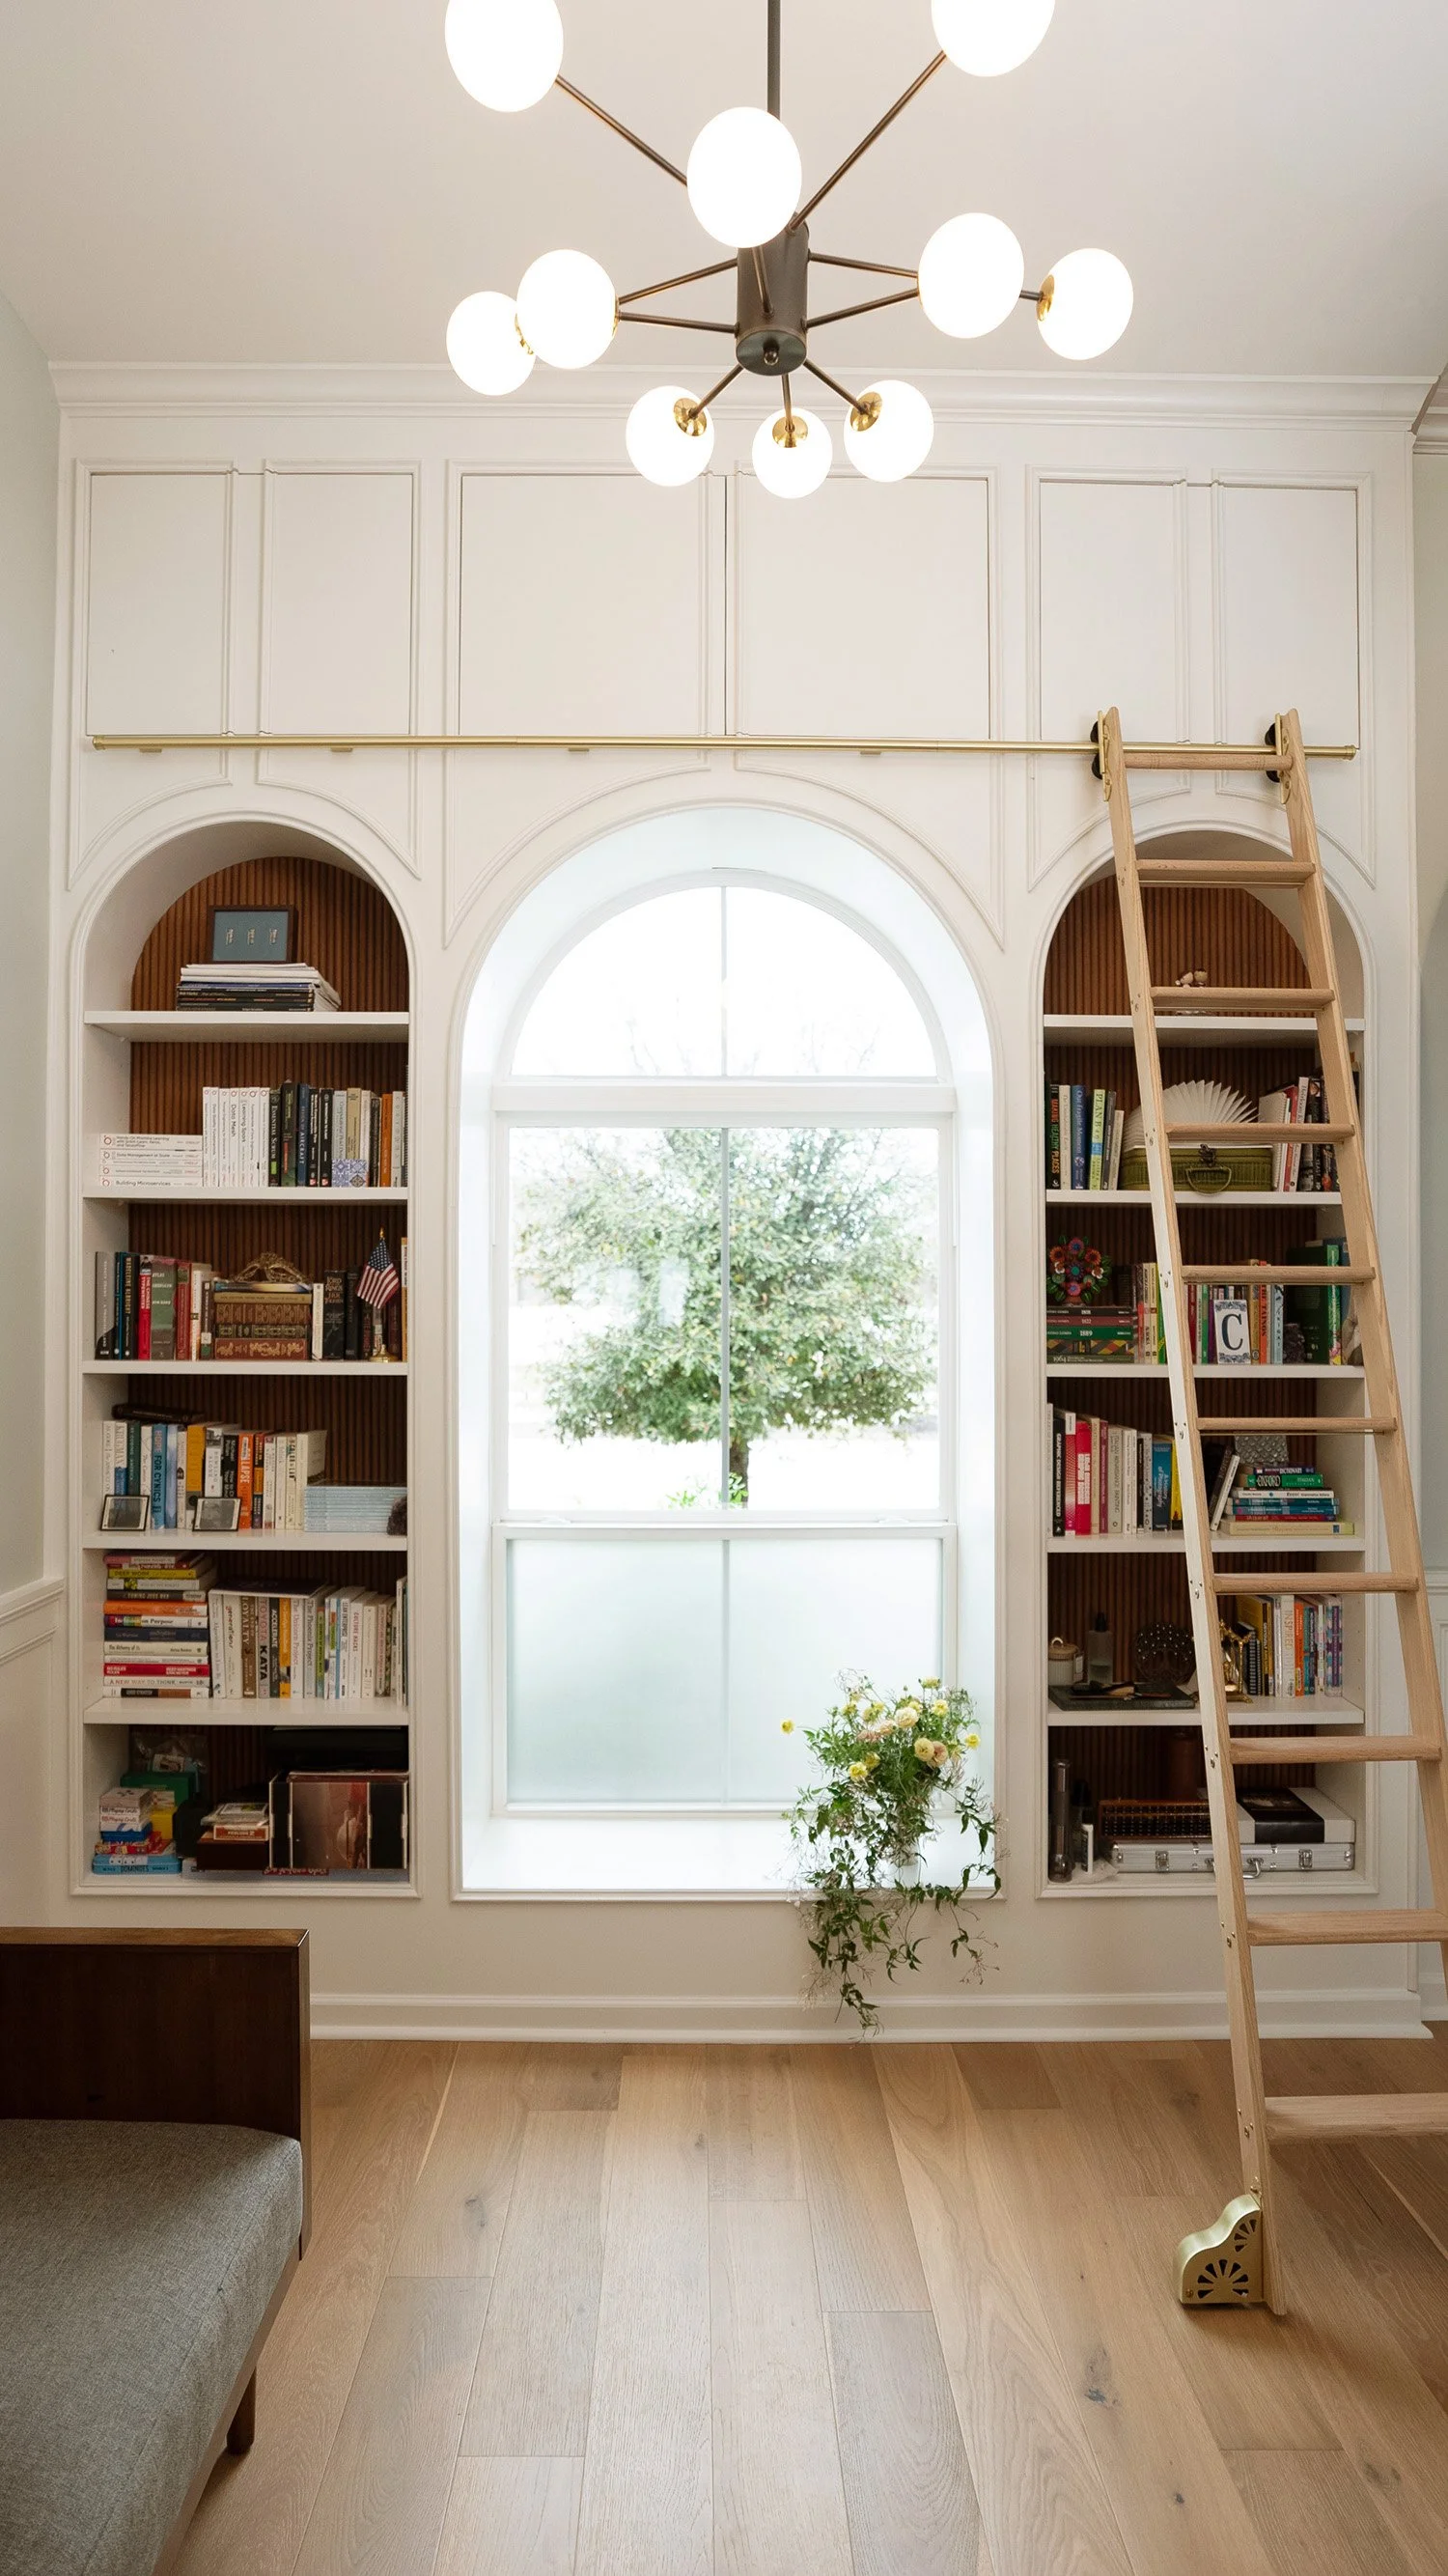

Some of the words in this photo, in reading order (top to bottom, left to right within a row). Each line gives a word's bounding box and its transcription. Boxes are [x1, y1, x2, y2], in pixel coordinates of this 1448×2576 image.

[1051, 1099, 1060, 1123] MAKING
[1095, 1093, 1103, 1120] PLAN
[1051, 1124, 1060, 1150] HEALTHY
[1051, 1150, 1060, 1174] PLACES
[1221, 1314, 1243, 1352] C
[153, 1430, 162, 1453] HOPE
[153, 1455, 162, 1471] FOR
[153, 1472, 162, 1502] CYNICS
[1257, 1475, 1281, 1487] OXFORD
[225, 1606, 236, 1649] generations
[1284, 1610, 1294, 1650] INSPIRED
